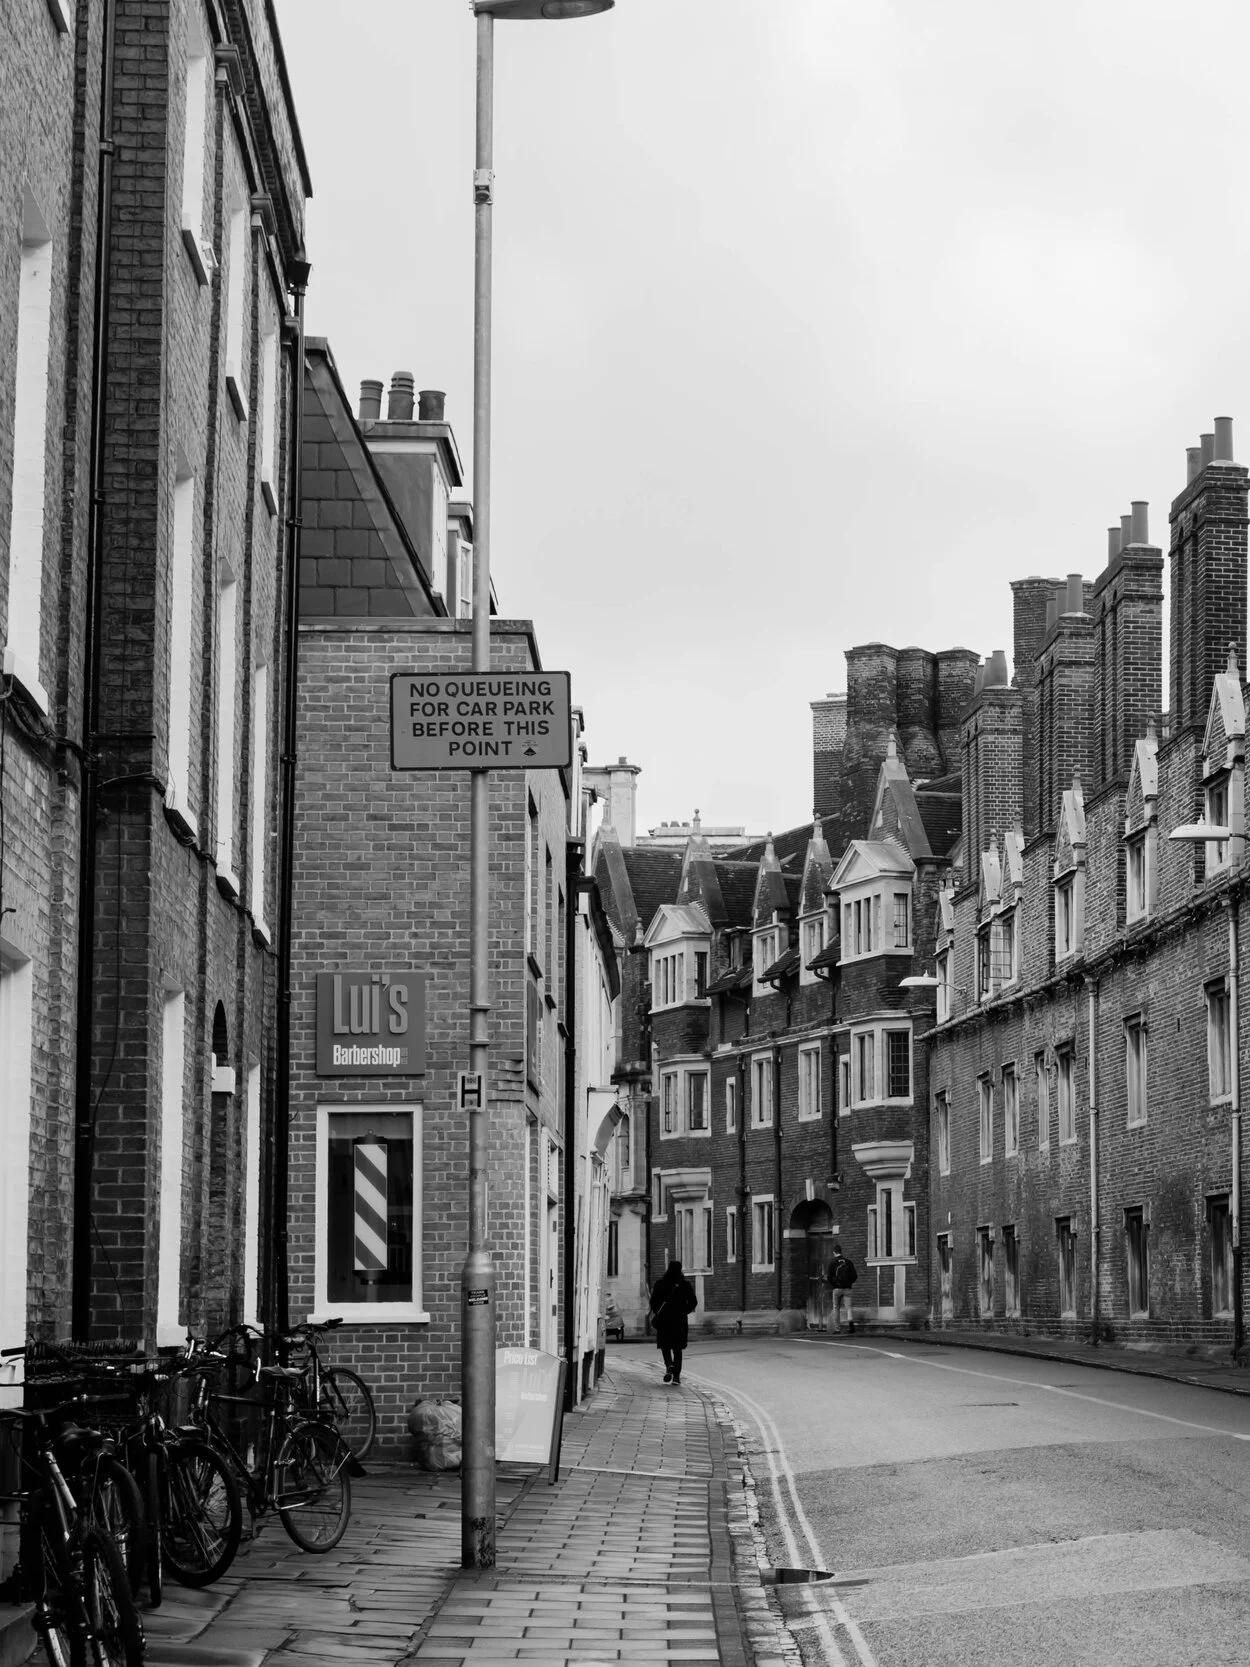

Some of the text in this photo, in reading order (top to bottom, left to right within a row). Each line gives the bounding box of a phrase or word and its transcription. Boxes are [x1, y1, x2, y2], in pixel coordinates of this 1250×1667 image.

[410, 681, 551, 698] NO QUEUEING
[410, 701, 554, 717] FOR CAR PARK
[413, 720, 549, 737] BEFORE THIS
[449, 741, 512, 756] POINT
[333, 974, 408, 1034] Lui's
[333, 1045, 400, 1067] Barbershop
[504, 1350, 537, 1366] Price List
